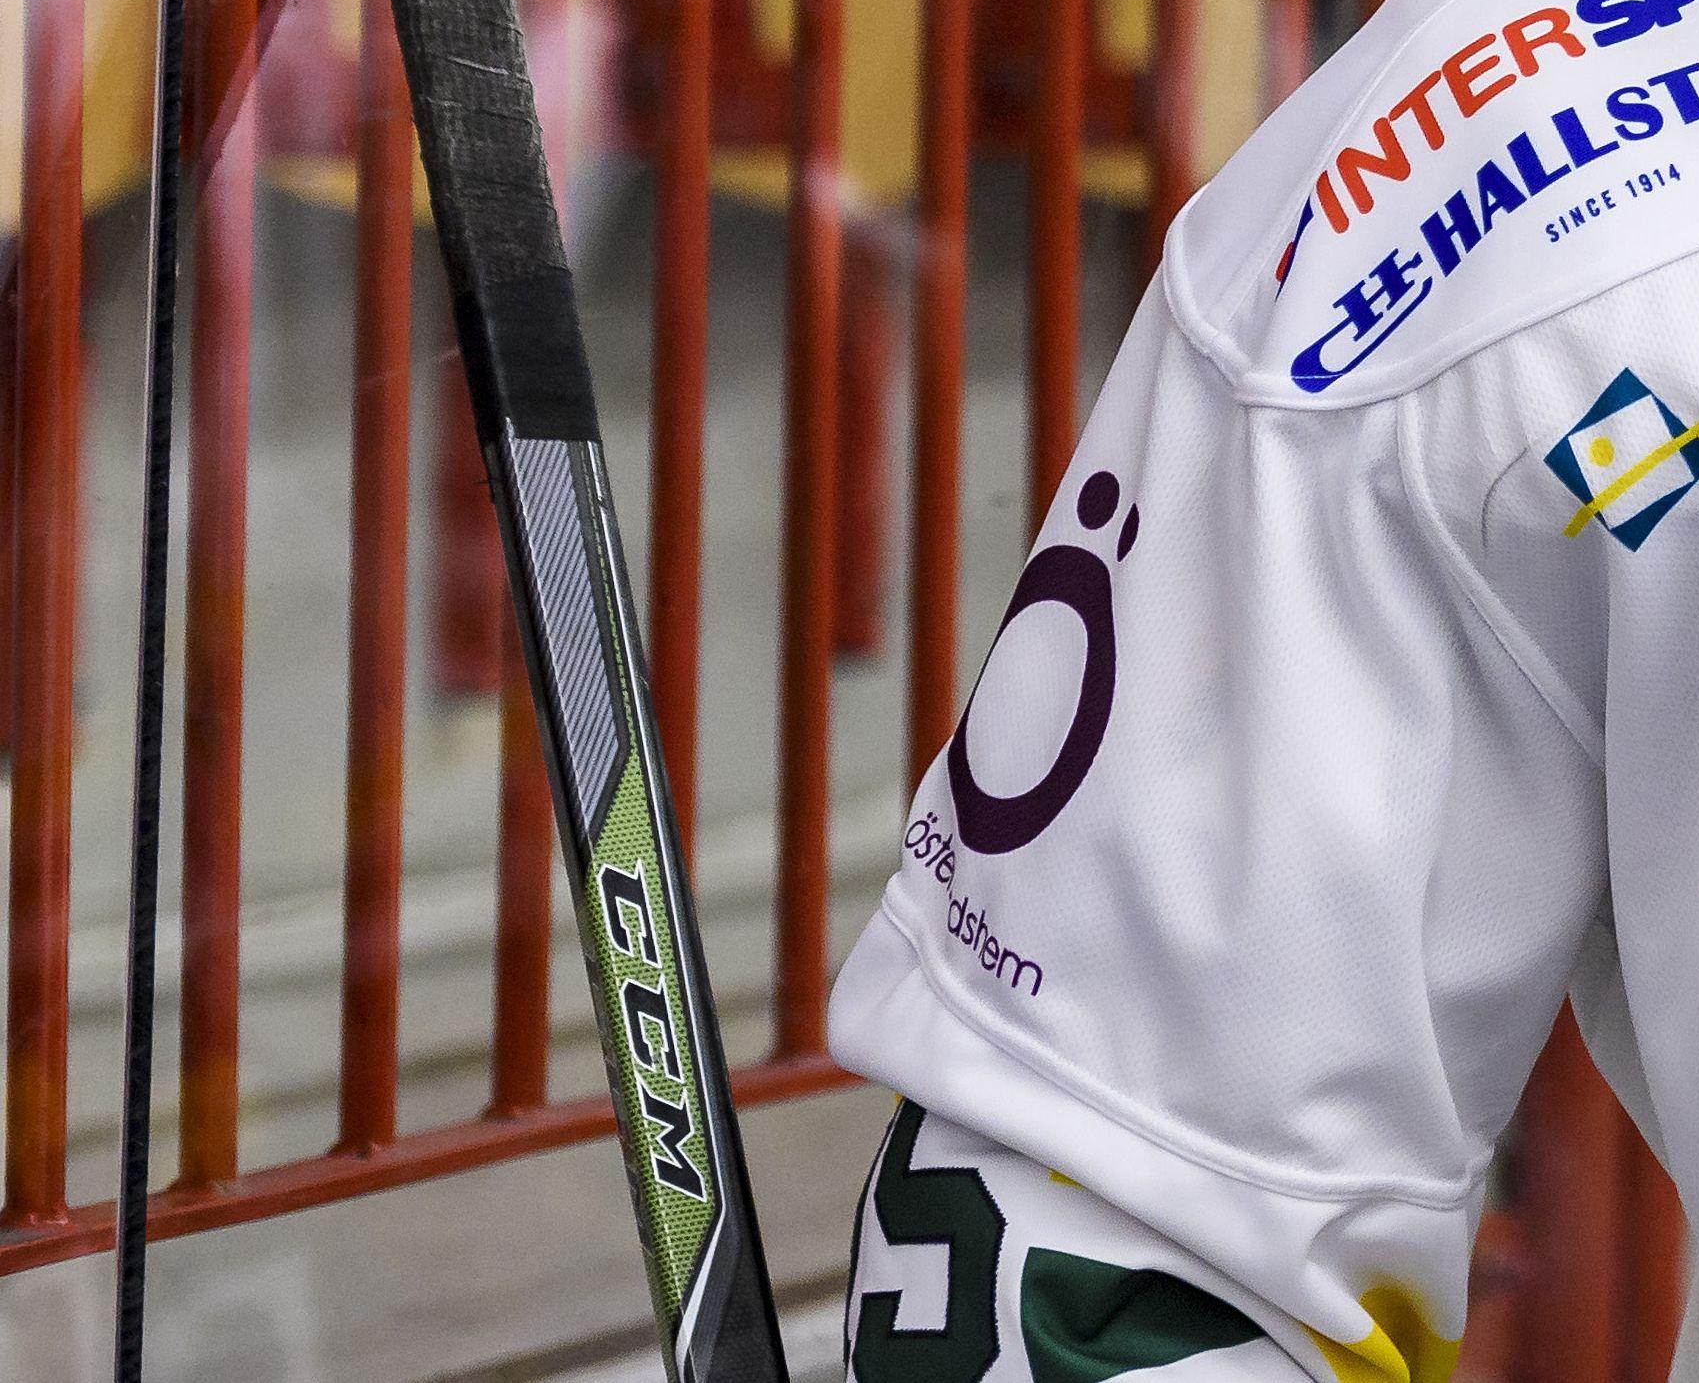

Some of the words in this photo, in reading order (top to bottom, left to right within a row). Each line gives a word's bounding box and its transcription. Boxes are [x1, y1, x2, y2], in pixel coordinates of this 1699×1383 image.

[1545, 189, 1617, 243] SINCE
[1624, 162, 1682, 199] 1914
[598, 857, 708, 1203] CCM
